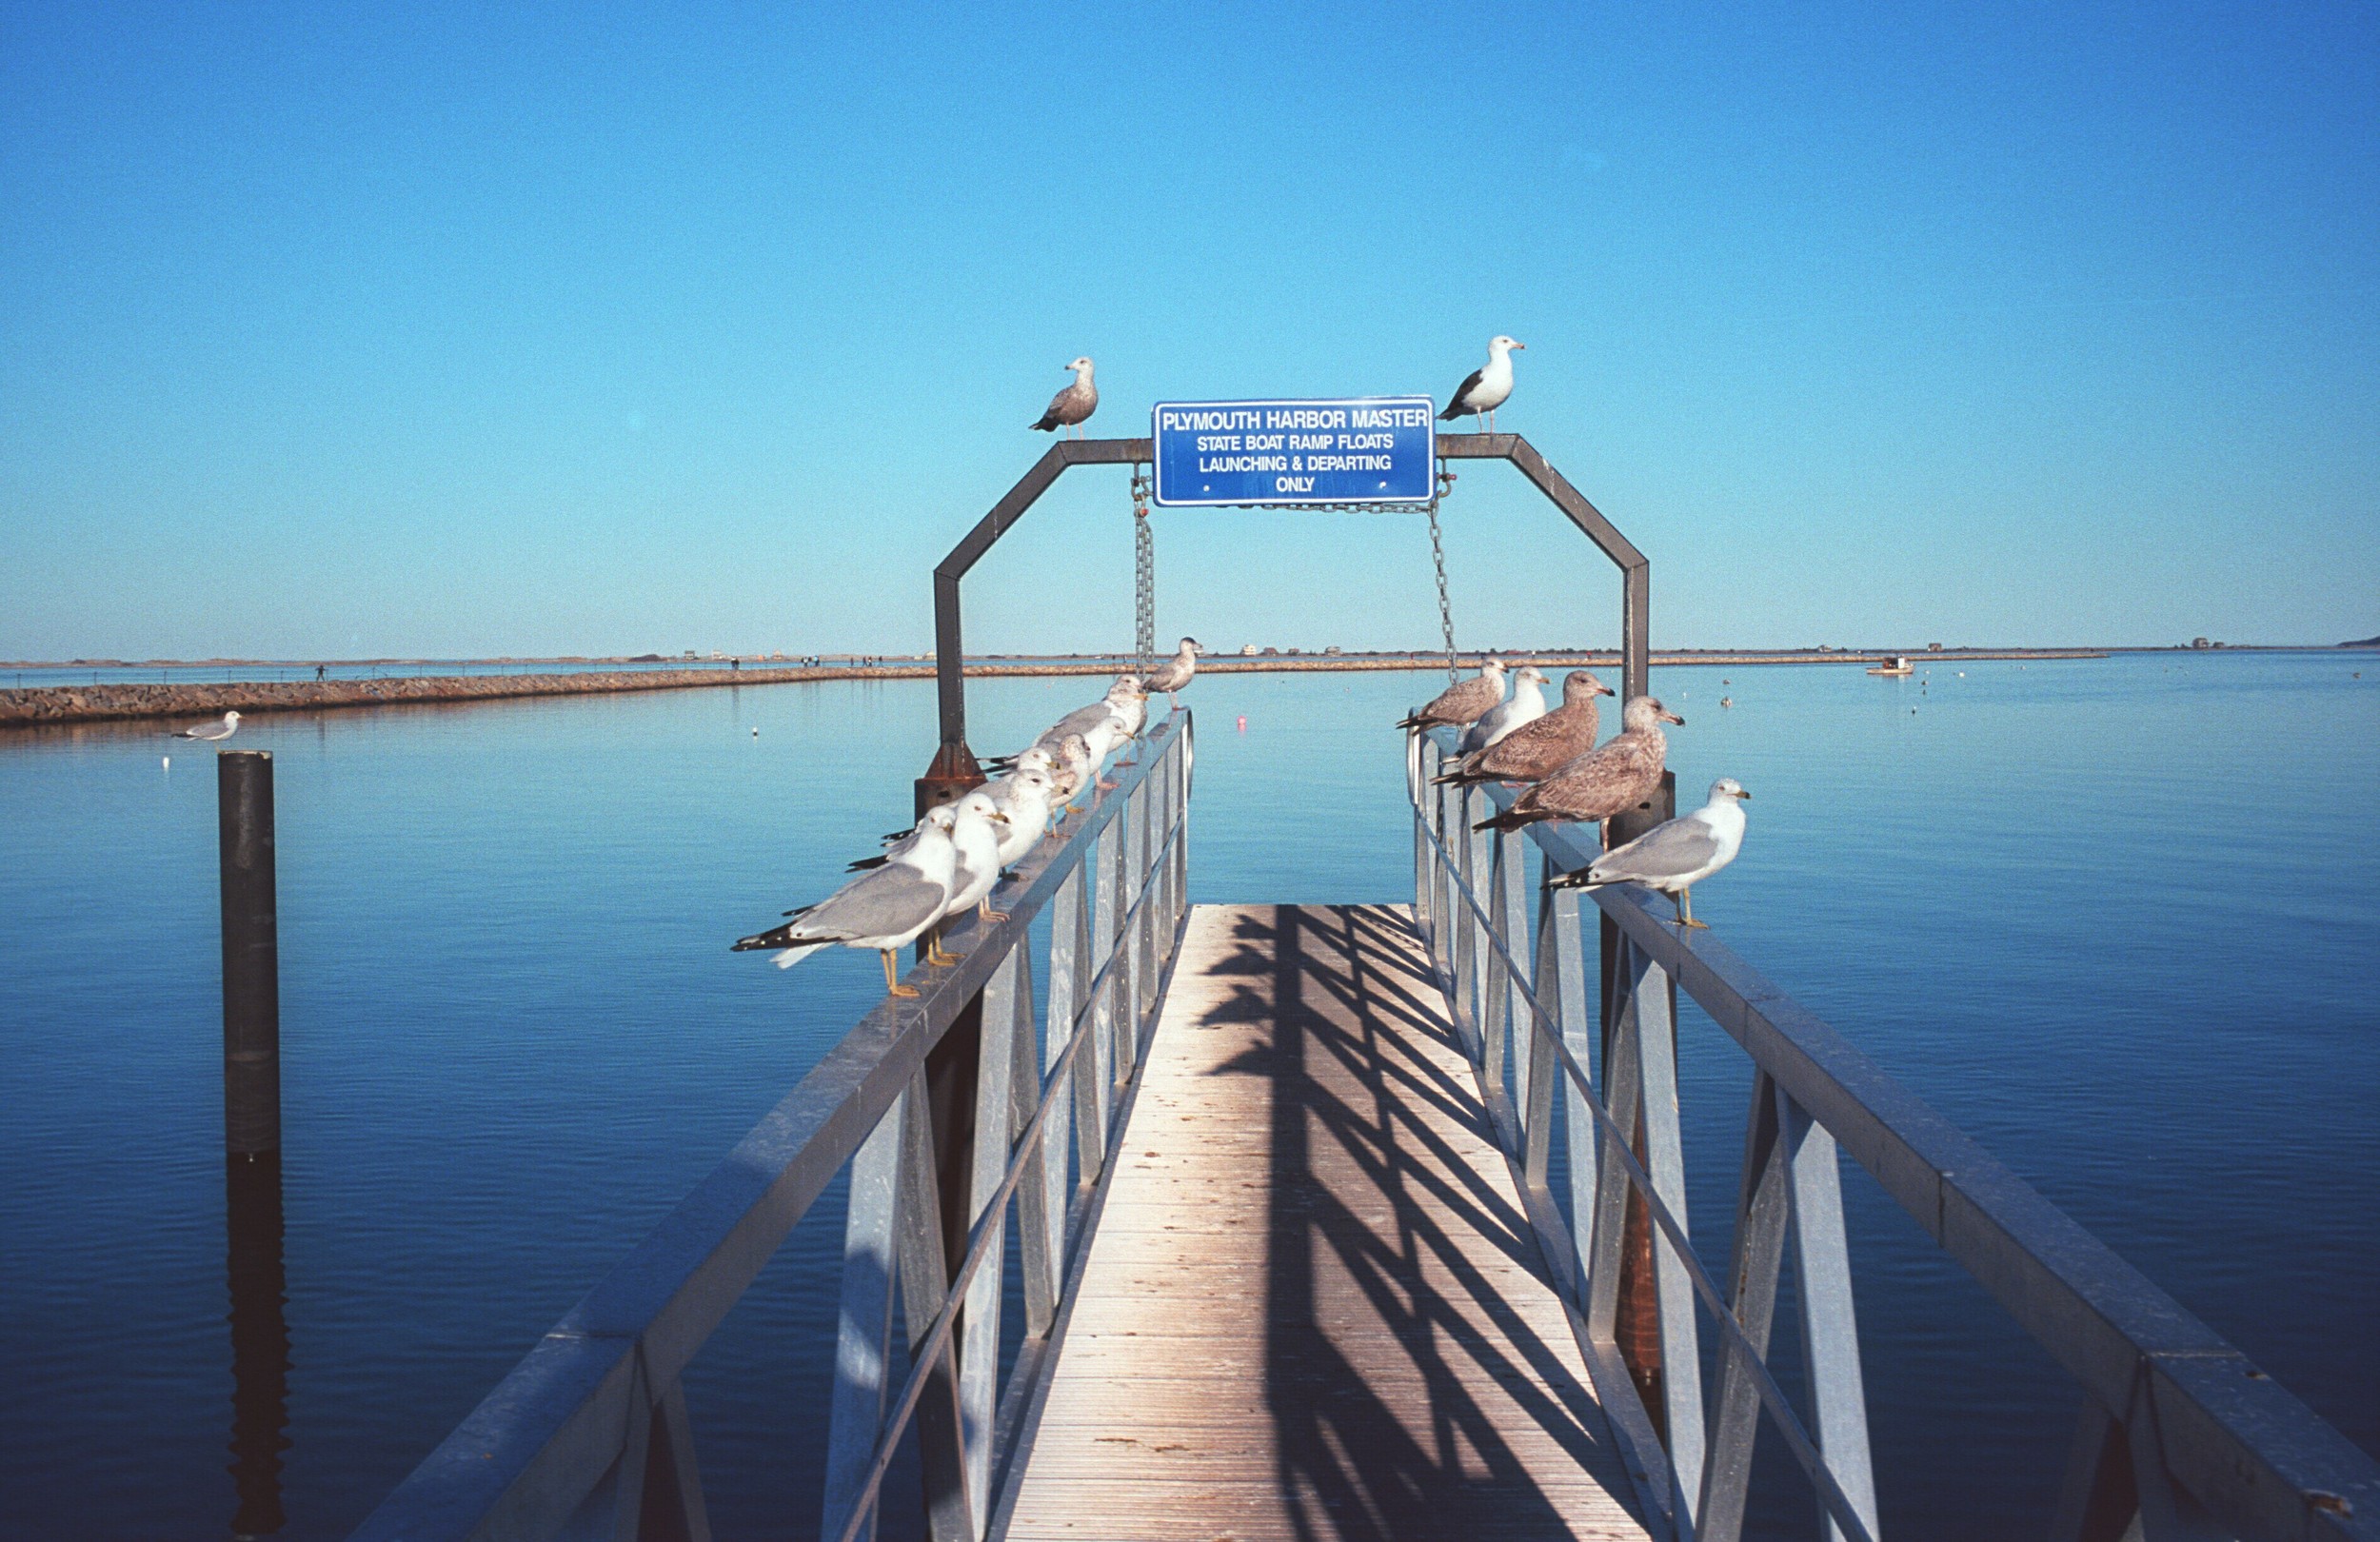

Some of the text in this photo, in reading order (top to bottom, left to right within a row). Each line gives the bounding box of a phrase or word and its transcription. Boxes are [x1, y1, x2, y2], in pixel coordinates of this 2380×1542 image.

[1162, 408, 1428, 430] PLYMOUTH HARBOR MASTER
[1197, 433, 1394, 451] STATE BOAT RAMP FLOATS
[1200, 455, 1391, 472] LAUNCHING & DEPARTING
[1276, 477, 1315, 492] ONLY
